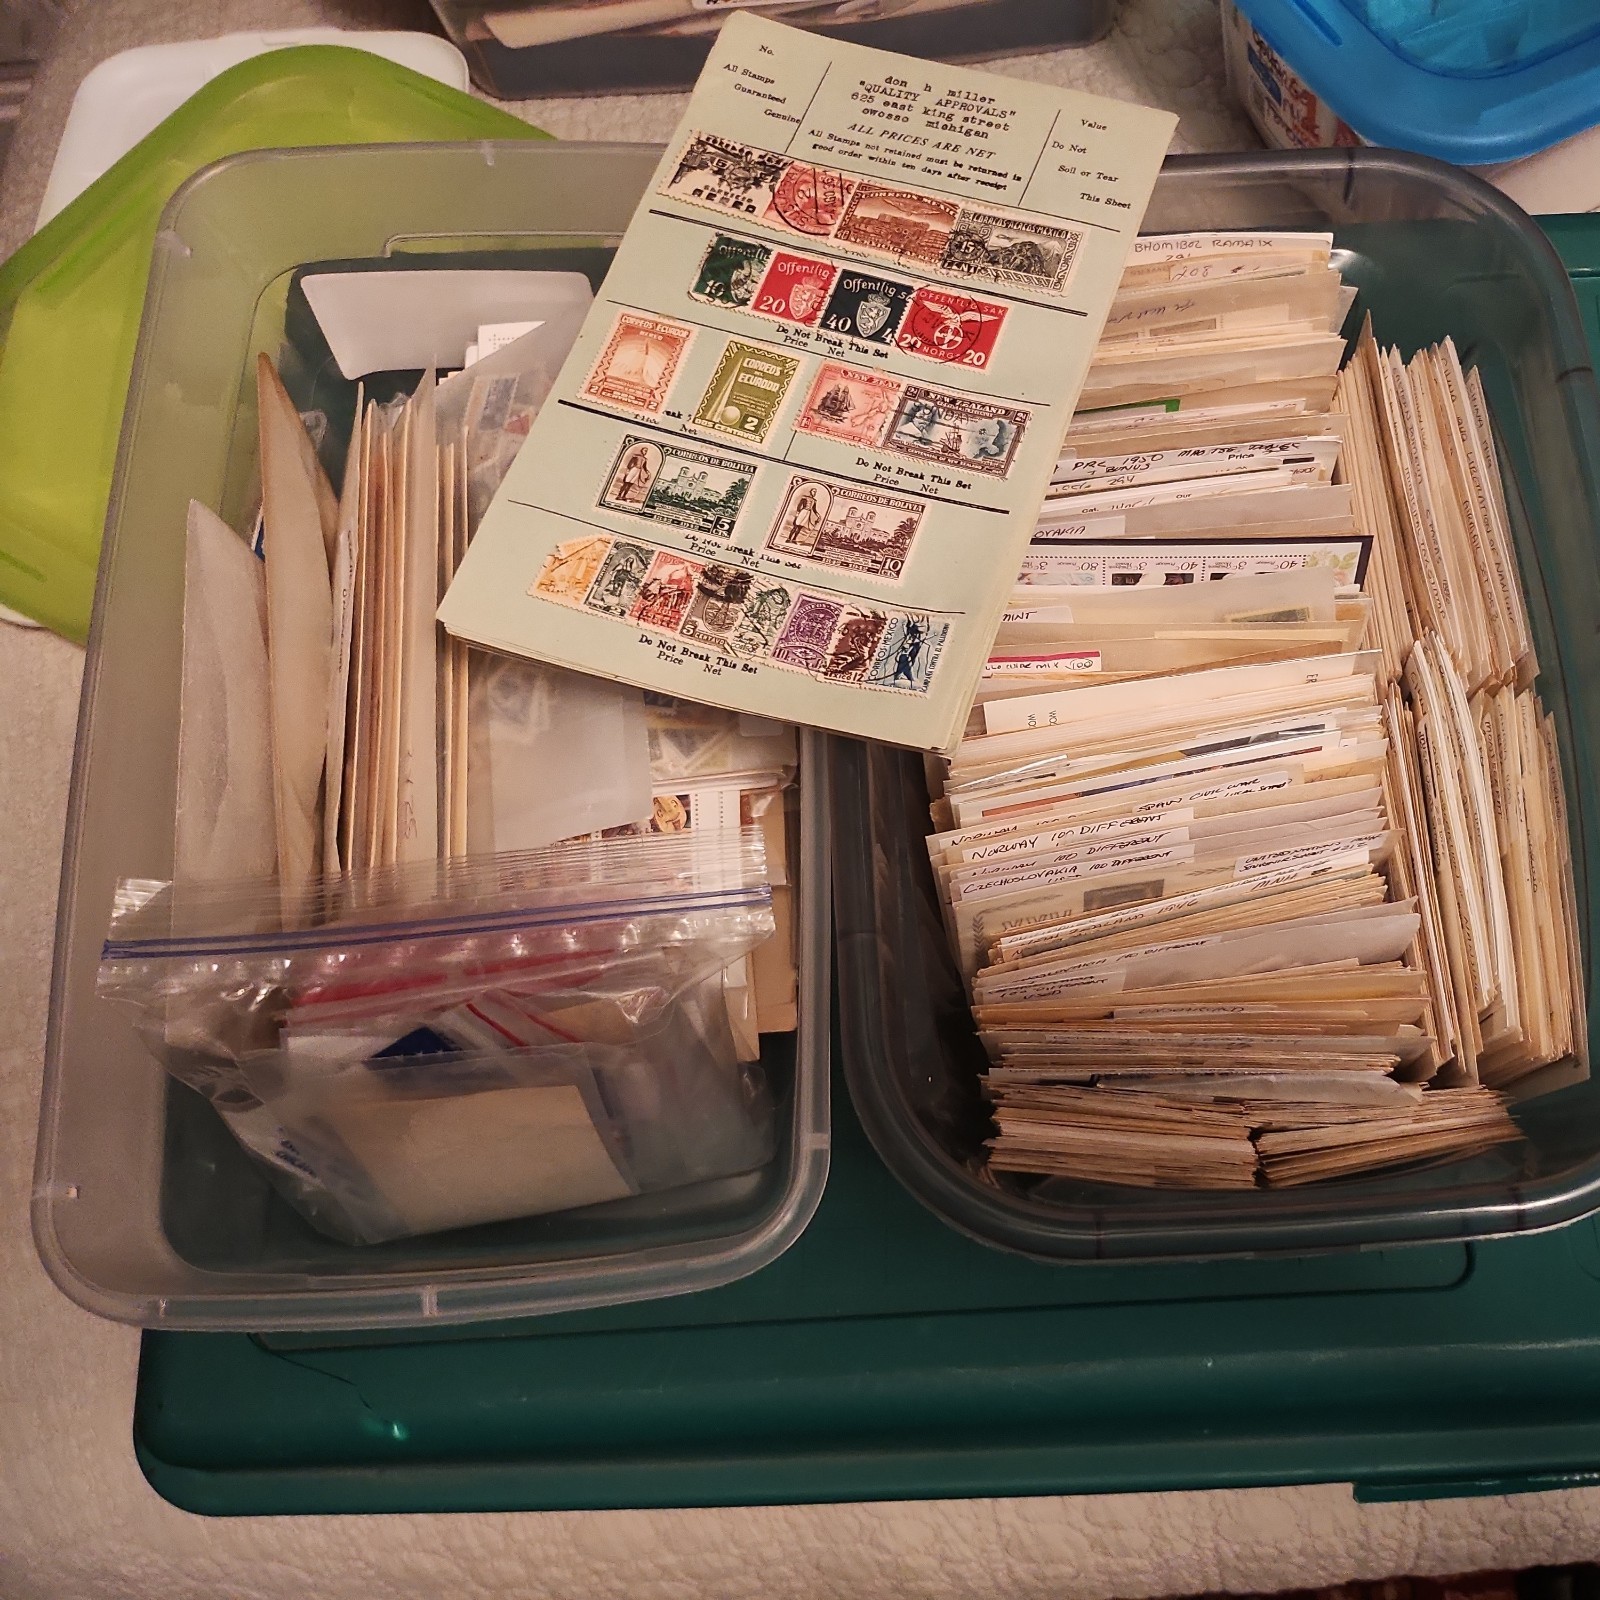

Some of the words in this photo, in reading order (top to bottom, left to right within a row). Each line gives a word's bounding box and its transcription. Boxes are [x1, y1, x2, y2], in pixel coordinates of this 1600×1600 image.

[759, 45, 775, 55] No.
[724, 63, 738, 72] All
[741, 68, 775, 84] Stamps
[734, 83, 786, 104] Guaranteed
[885, 76, 908, 88] don
[924, 83, 932, 92] h
[947, 89, 996, 105] miller
[764, 109, 800, 124] Genuine
[851, 92, 875, 104] 625
[883, 100, 914, 112] east
[922, 107, 955, 122] king
[961, 116, 1010, 131] street
[862, 108, 909, 123] owosso
[925, 120, 989, 139] michigan
[1081, 119, 1107, 130] Value
[847, 123, 874, 135] ALL
[879, 129, 929, 146] PRICES
[932, 140, 962, 152] ARE
[965, 147, 996, 160] NET
[1052, 141, 1064, 150] Do
[1069, 144, 1087, 154] Not
[808, 129, 823, 138] All
[827, 133, 861, 148] Stamps
[865, 142, 880, 151] not
[884, 146, 921, 160] retained
[926, 156, 948, 166] must
[953, 160, 963, 168] be
[968, 164, 1008, 179] returned
[1013, 174, 1022, 182] in
[811, 142, 834, 153] good
[838, 146, 863, 159] order
[868, 155, 897, 166] within
[902, 162, 916, 170] ten
[921, 166, 942, 177] days
[947, 172, 971, 182] after
[975, 179, 1008, 191] receipt
[1057, 165, 1076, 174] Soil
[1096, 172, 1118, 182] Tear
[1080, 193, 1100, 203] This
[1105, 197, 1132, 209] Sheet
[759, 295, 786, 314] 20
[983, 304, 1006, 316] SAK
[826, 313, 851, 332] 40
[776, 325, 789, 335] Do
[793, 328, 811, 339] Not
[815, 333, 844, 348] Break
[849, 341, 869, 355] This
[872, 349, 889, 359] Set
[783, 335, 809, 348] Price
[827, 347, 845, 358] Net
[743, 357, 783, 376] CORREOS
[962, 350, 986, 366] 20
[738, 373, 780, 392] ECUADOR
[742, 416, 760, 431] 2
[672, 449, 709, 465] CORREOS
[709, 457, 721, 466] DE
[721, 460, 755, 473] BOLIVIA
[1228, 452, 1255, 460] Price
[855, 457, 870, 467] Do
[872, 461, 892, 474] Not
[896, 467, 926, 481] Break
[930, 475, 952, 486] This
[955, 480, 972, 490] Set
[873, 473, 900, 486] Price
[919, 484, 939, 494] Net
[839, 488, 878, 503] CORREOS
[878, 496, 889, 505] DE
[889, 500, 924, 512] BOLIVIA
[715, 519, 731, 530] 5
[689, 542, 717, 557] Price
[740, 556, 760, 568] Net
[884, 557, 903, 572] 10
[683, 624, 694, 636] 5
[882, 617, 900, 648] MEXICO
[638, 634, 653, 646] Do
[657, 639, 677, 655] Not
[680, 647, 710, 662] Break
[716, 656, 737, 670] This
[741, 662, 758, 675] Set
[656, 650, 684, 666] Price
[702, 664, 722, 676] Net
[971, 836, 1040, 860] NORWAY
[963, 864, 1078, 894] CZECHOSLOVAKIA
